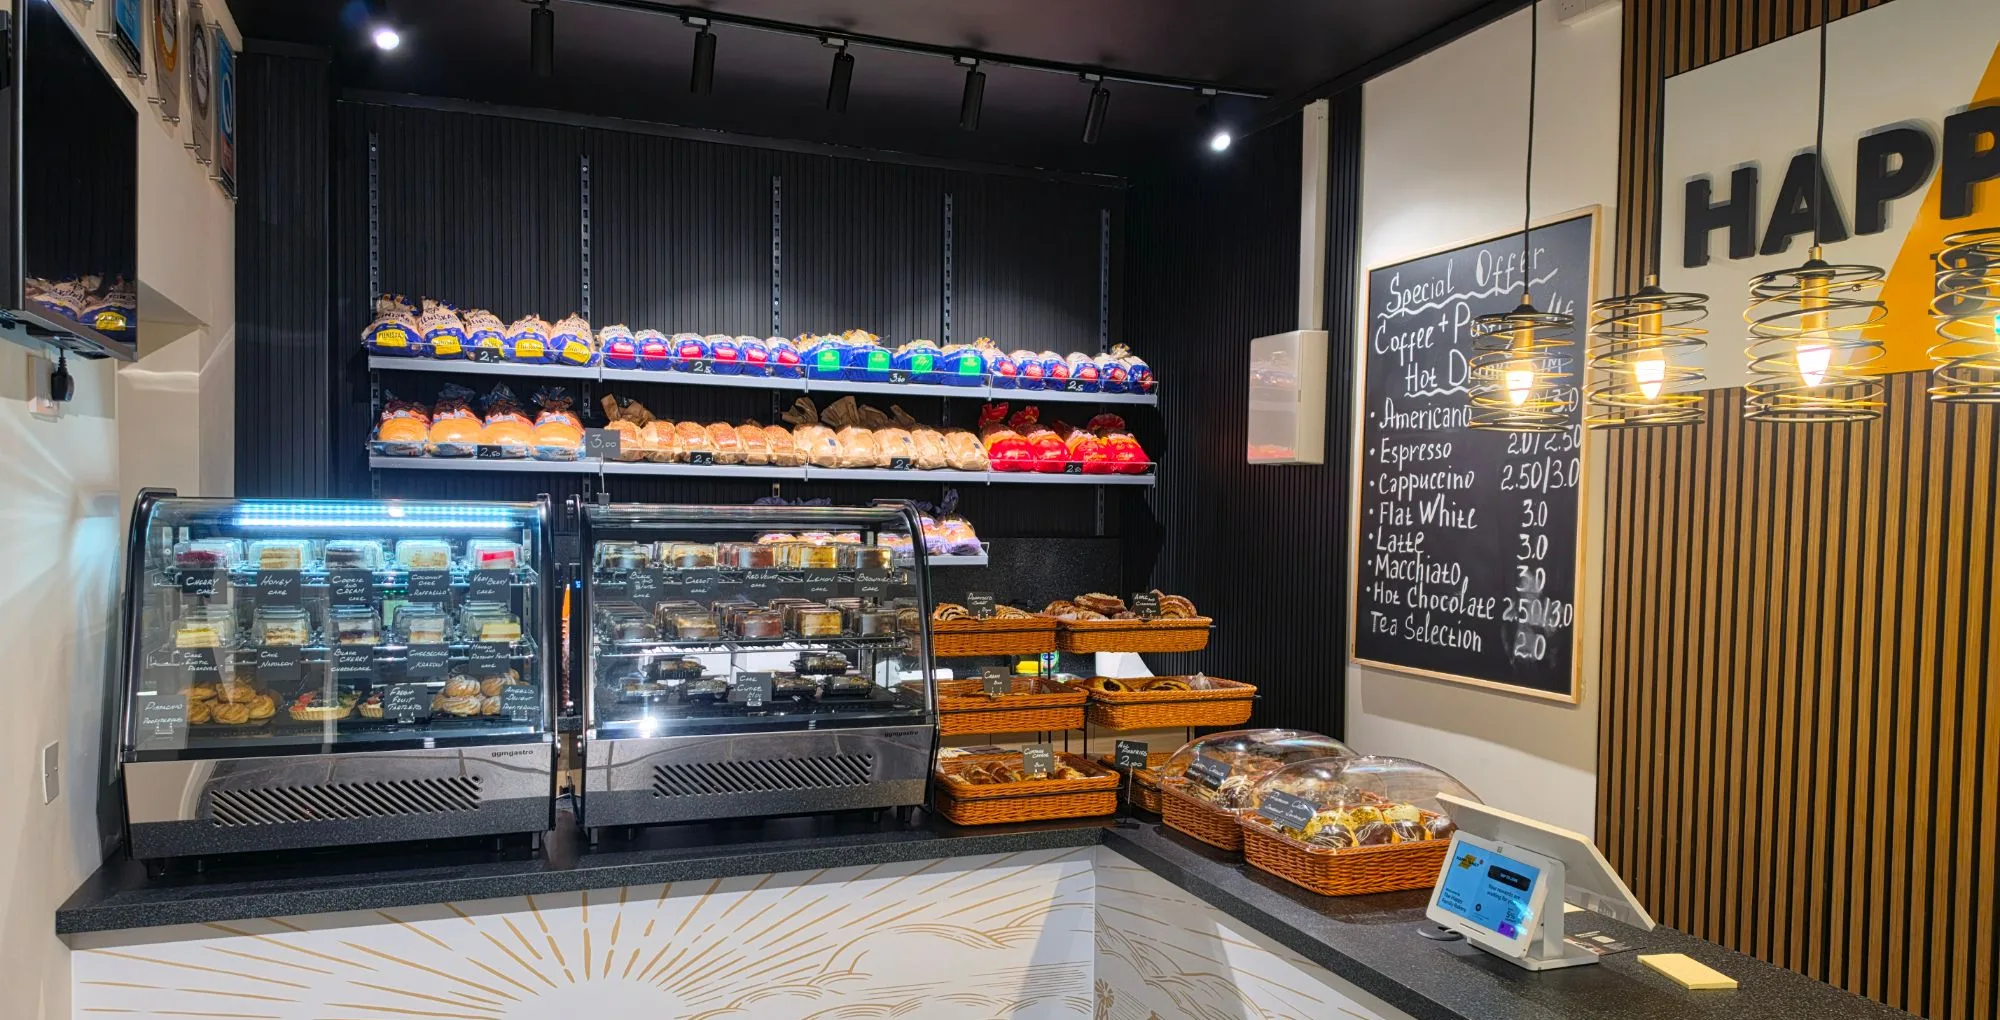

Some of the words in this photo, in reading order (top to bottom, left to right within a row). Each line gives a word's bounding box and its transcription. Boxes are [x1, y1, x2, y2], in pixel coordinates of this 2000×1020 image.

[1387, 259, 1454, 316] Special
[1476, 247, 1544, 296] Offer
[1375, 320, 1434, 366] Coffee
[1438, 313, 1448, 333] +
[1405, 362, 1437, 392] Hot
[1379, 397, 1472, 429] Americano
[1380, 437, 1452, 471] Espresso
[1378, 465, 1475, 501] Cappuccino
[1501, 456, 1580, 493] 2.50/3.0
[1379, 503, 1413, 526] Flat
[1419, 493, 1478, 529] White
[1521, 498, 1548, 527] 3.0
[1377, 526, 1424, 552] Latte
[1517, 533, 1548, 560] 3.0
[1375, 550, 1461, 585] Macchiato
[1374, 582, 1400, 605] Hot
[1408, 576, 1496, 620] Chocolate
[1502, 597, 1573, 627] 2.50/3.0
[1371, 610, 1398, 636] Tea
[1404, 612, 1482, 652] Selection
[1513, 631, 1546, 660] 2.0
